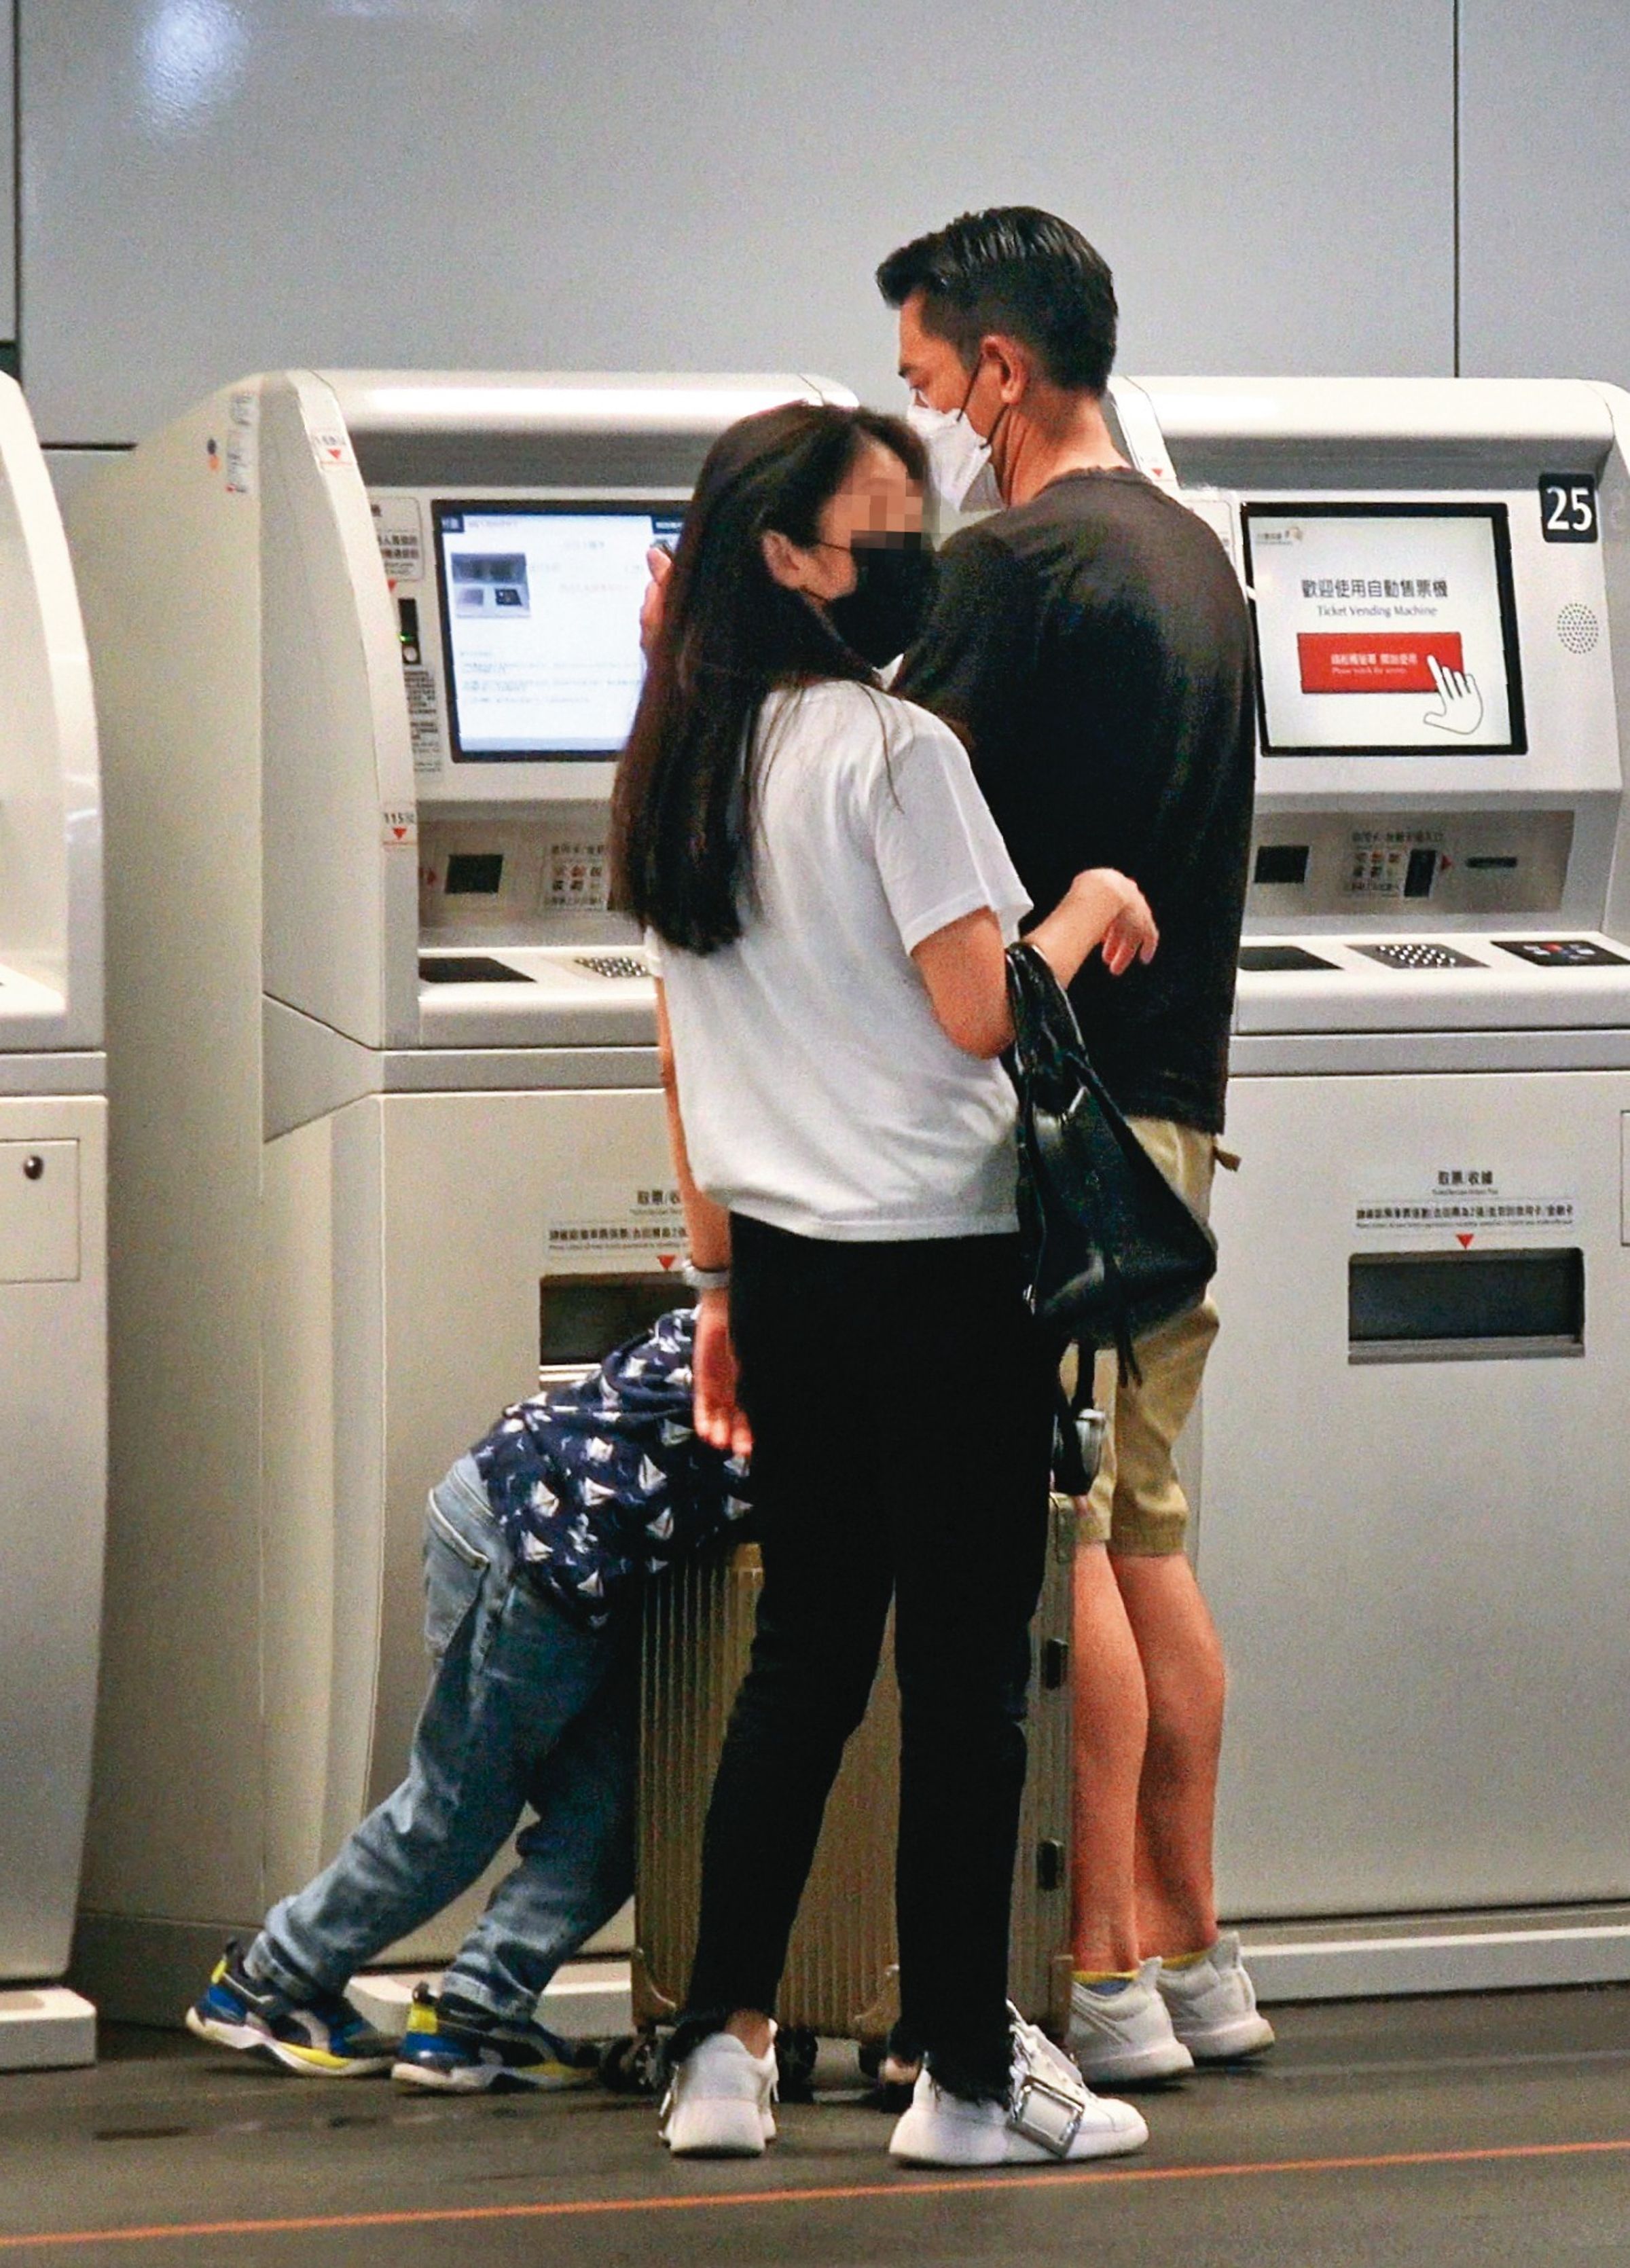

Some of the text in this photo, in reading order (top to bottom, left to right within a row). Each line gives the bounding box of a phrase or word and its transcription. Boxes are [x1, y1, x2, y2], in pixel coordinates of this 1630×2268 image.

[1546, 486, 1593, 532] 25
[1301, 579, 1448, 598] 歡迎使用自動售票機
[1318, 604, 1437, 617] Ticket Vending Machine
